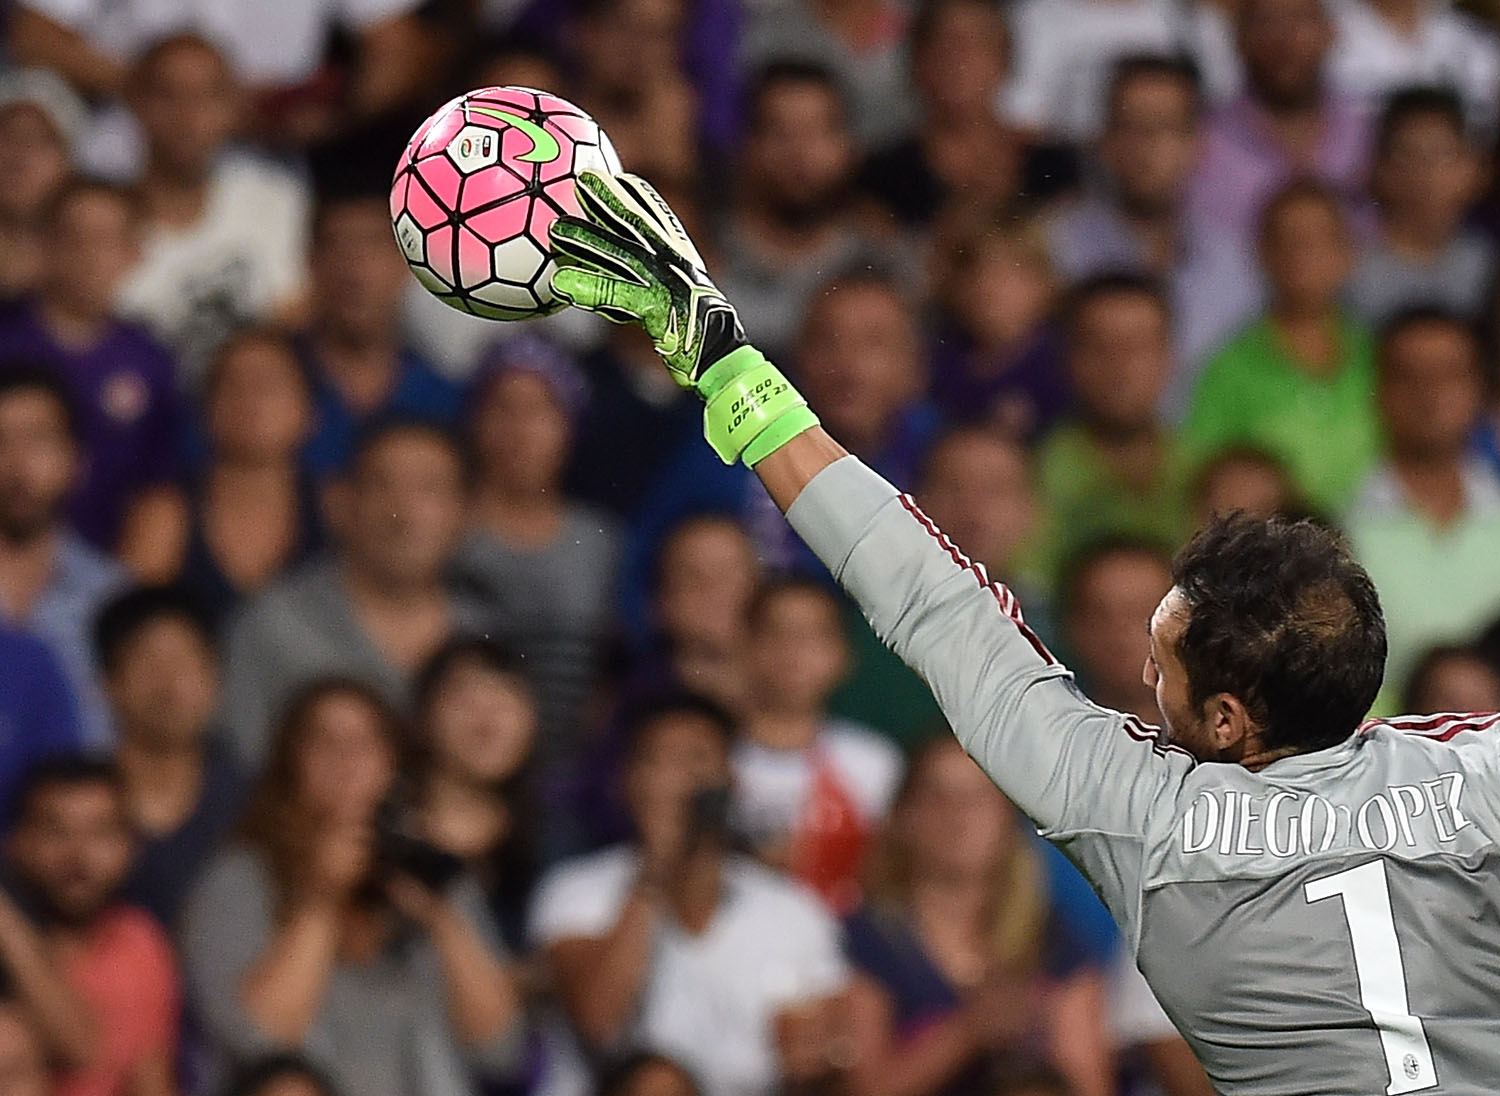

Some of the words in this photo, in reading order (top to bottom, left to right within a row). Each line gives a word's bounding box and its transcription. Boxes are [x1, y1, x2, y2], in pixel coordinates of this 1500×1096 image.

[731, 378, 772, 414] DIEGO
[1182, 791, 1337, 858] DIEGO
[1304, 857, 1439, 1096] 1
